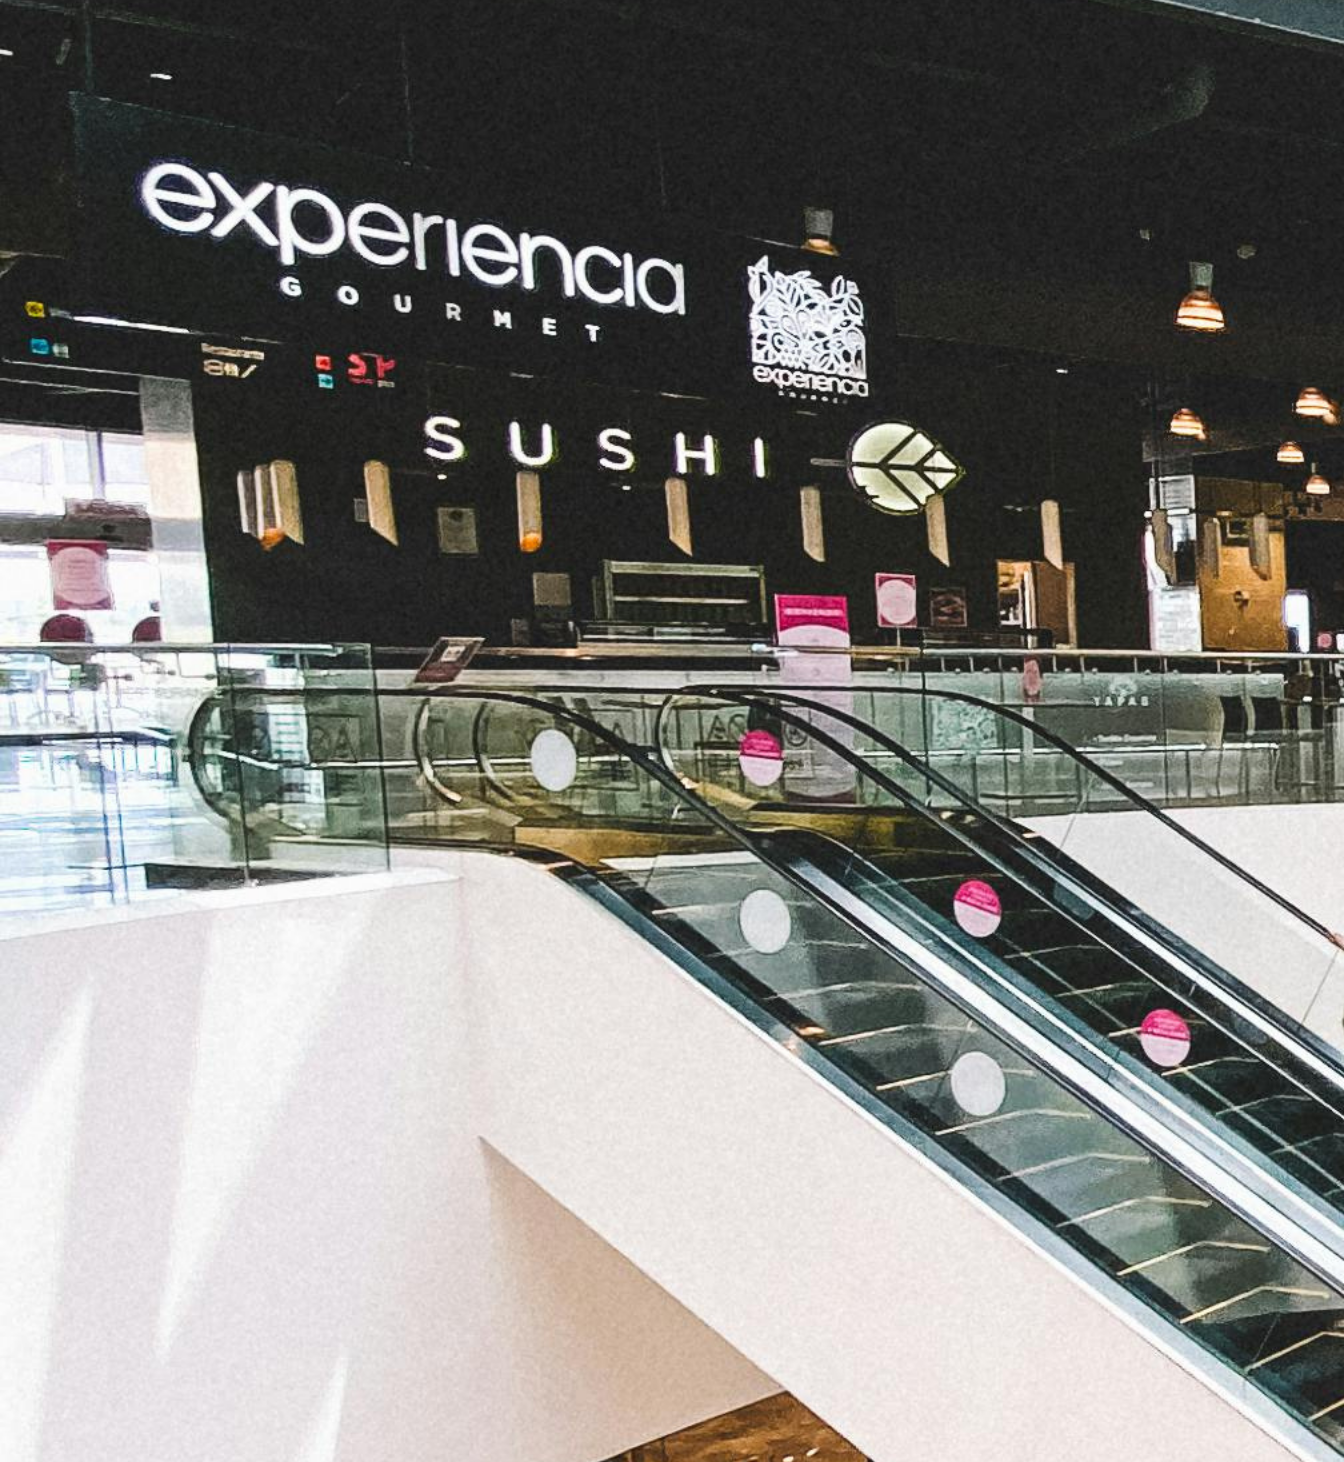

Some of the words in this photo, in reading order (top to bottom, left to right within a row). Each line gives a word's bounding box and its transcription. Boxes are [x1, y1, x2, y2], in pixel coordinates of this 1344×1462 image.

[141, 160, 687, 316] experiencia
[279, 275, 602, 342] GOURMET
[424, 414, 766, 480] SUSHI
